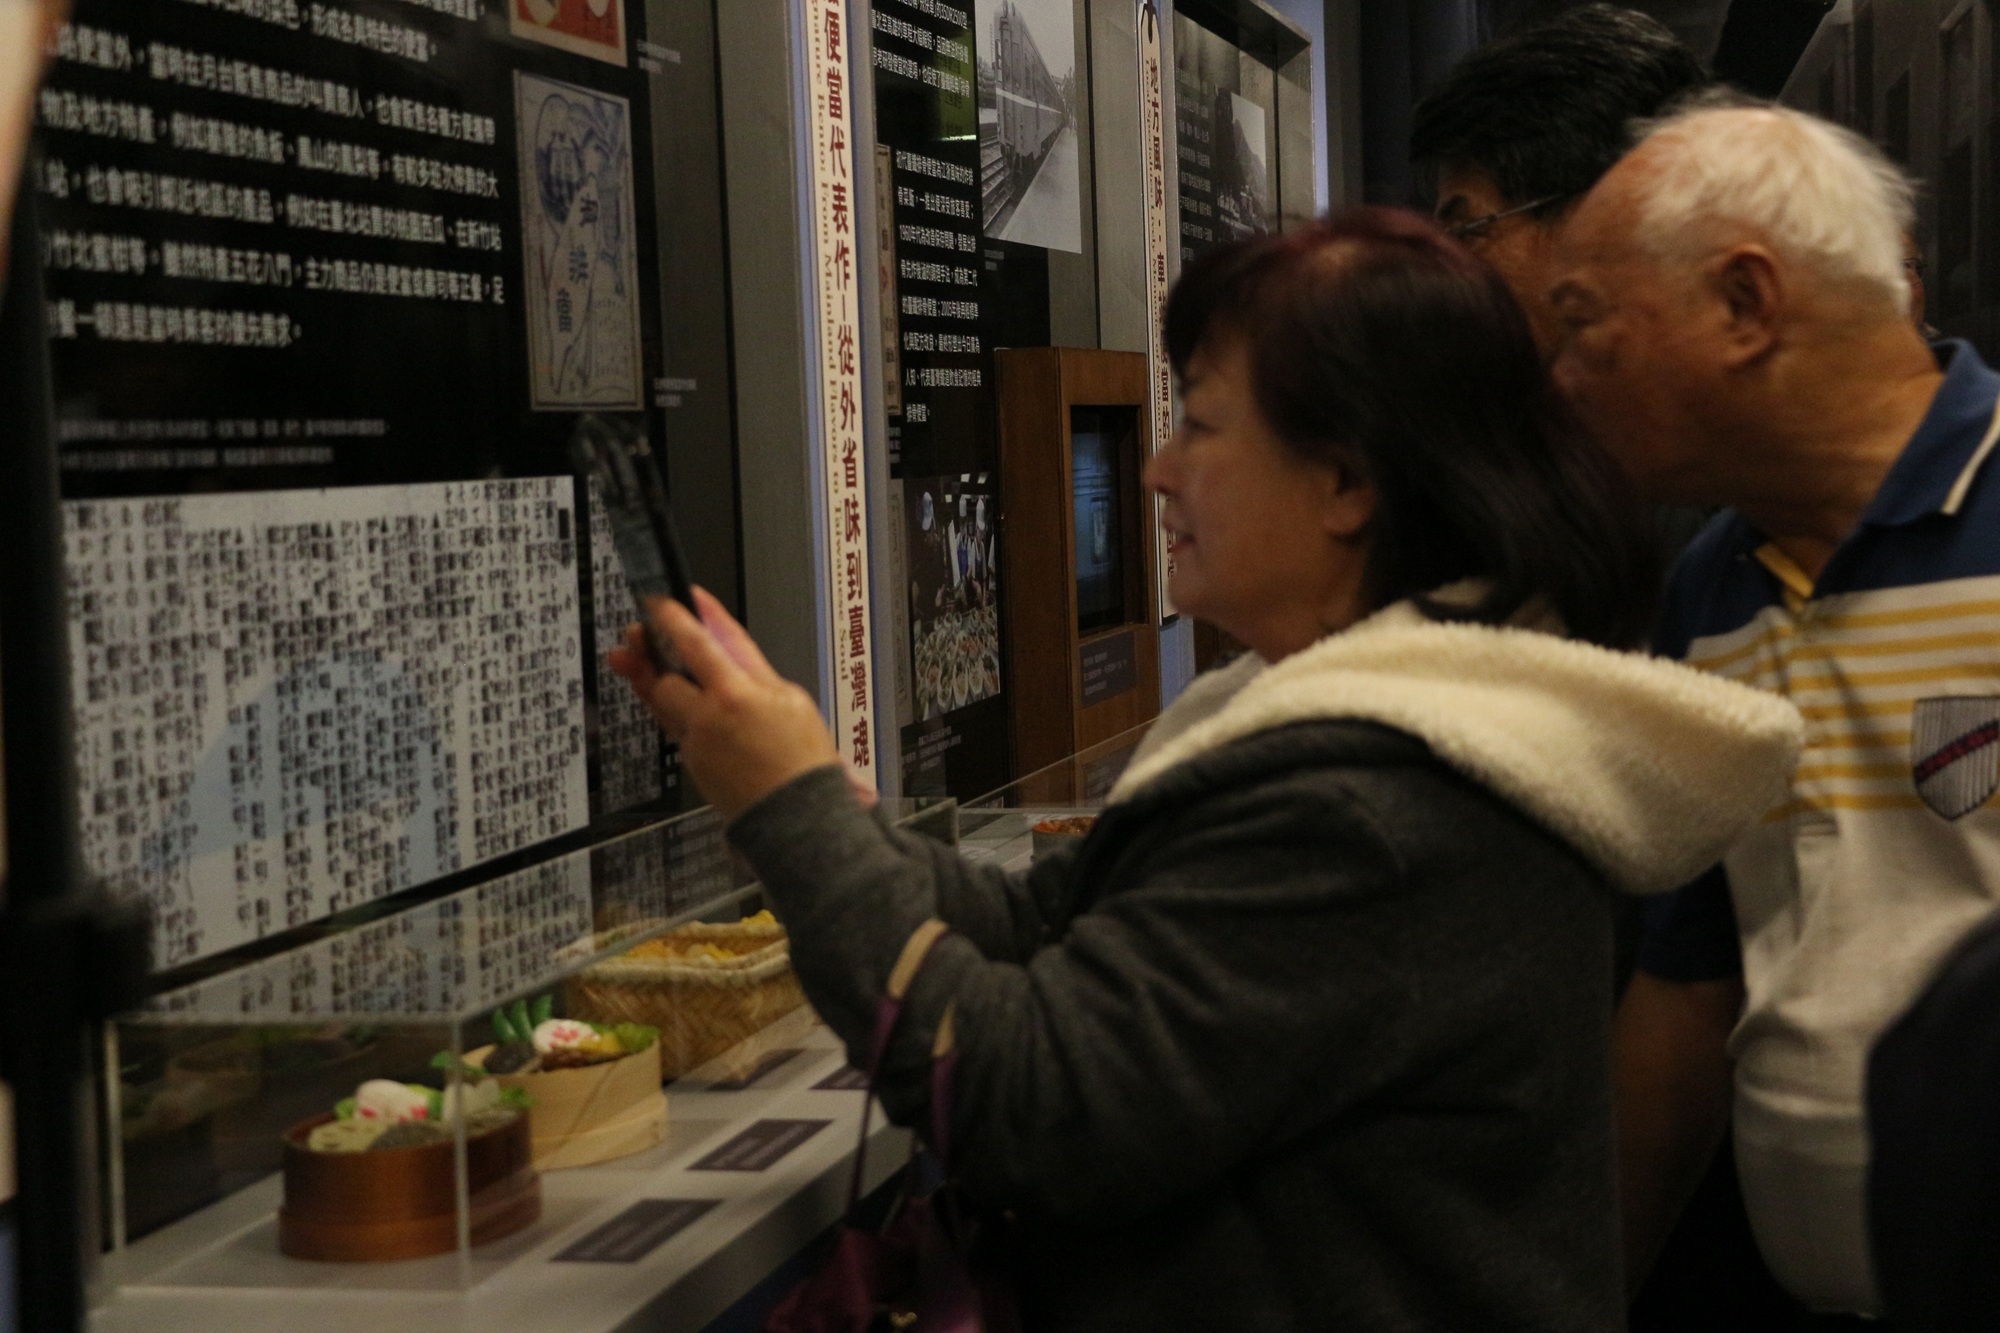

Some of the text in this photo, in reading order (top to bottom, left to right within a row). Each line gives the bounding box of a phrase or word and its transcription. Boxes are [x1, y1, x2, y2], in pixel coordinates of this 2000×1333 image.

[821, 181, 830, 245] From
[824, 254, 837, 370] Mainland
[829, 379, 838, 463] Flavors
[834, 499, 844, 622] Taiwanese
[839, 628, 849, 681] Soul
